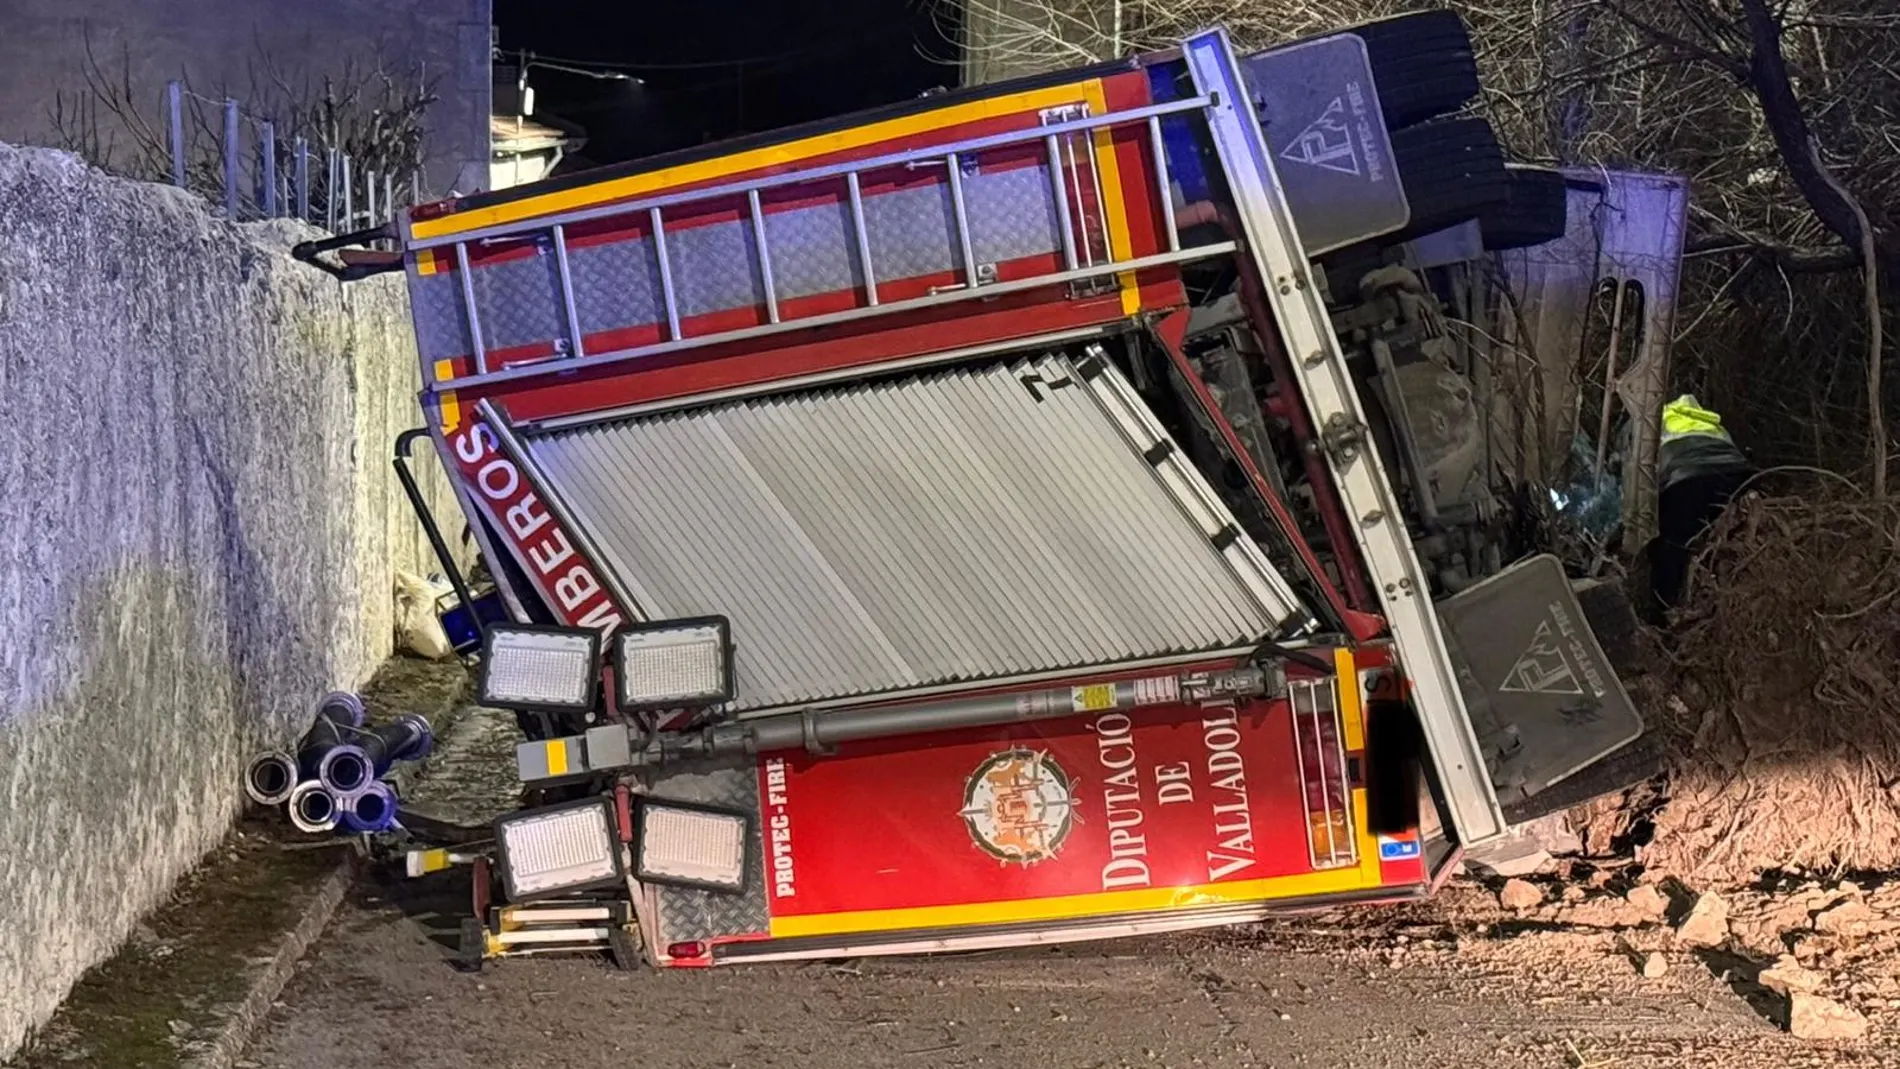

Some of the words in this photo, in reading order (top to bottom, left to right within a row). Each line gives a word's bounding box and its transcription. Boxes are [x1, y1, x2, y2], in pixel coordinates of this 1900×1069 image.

[455, 420, 622, 656] MBEROS
[766, 757, 796, 898] PROTEC-FIRE
[1085, 713, 1151, 890] DIPUTACIÓ
[1155, 761, 1194, 806] DE
[1200, 698, 1257, 882] VALLADOLI
